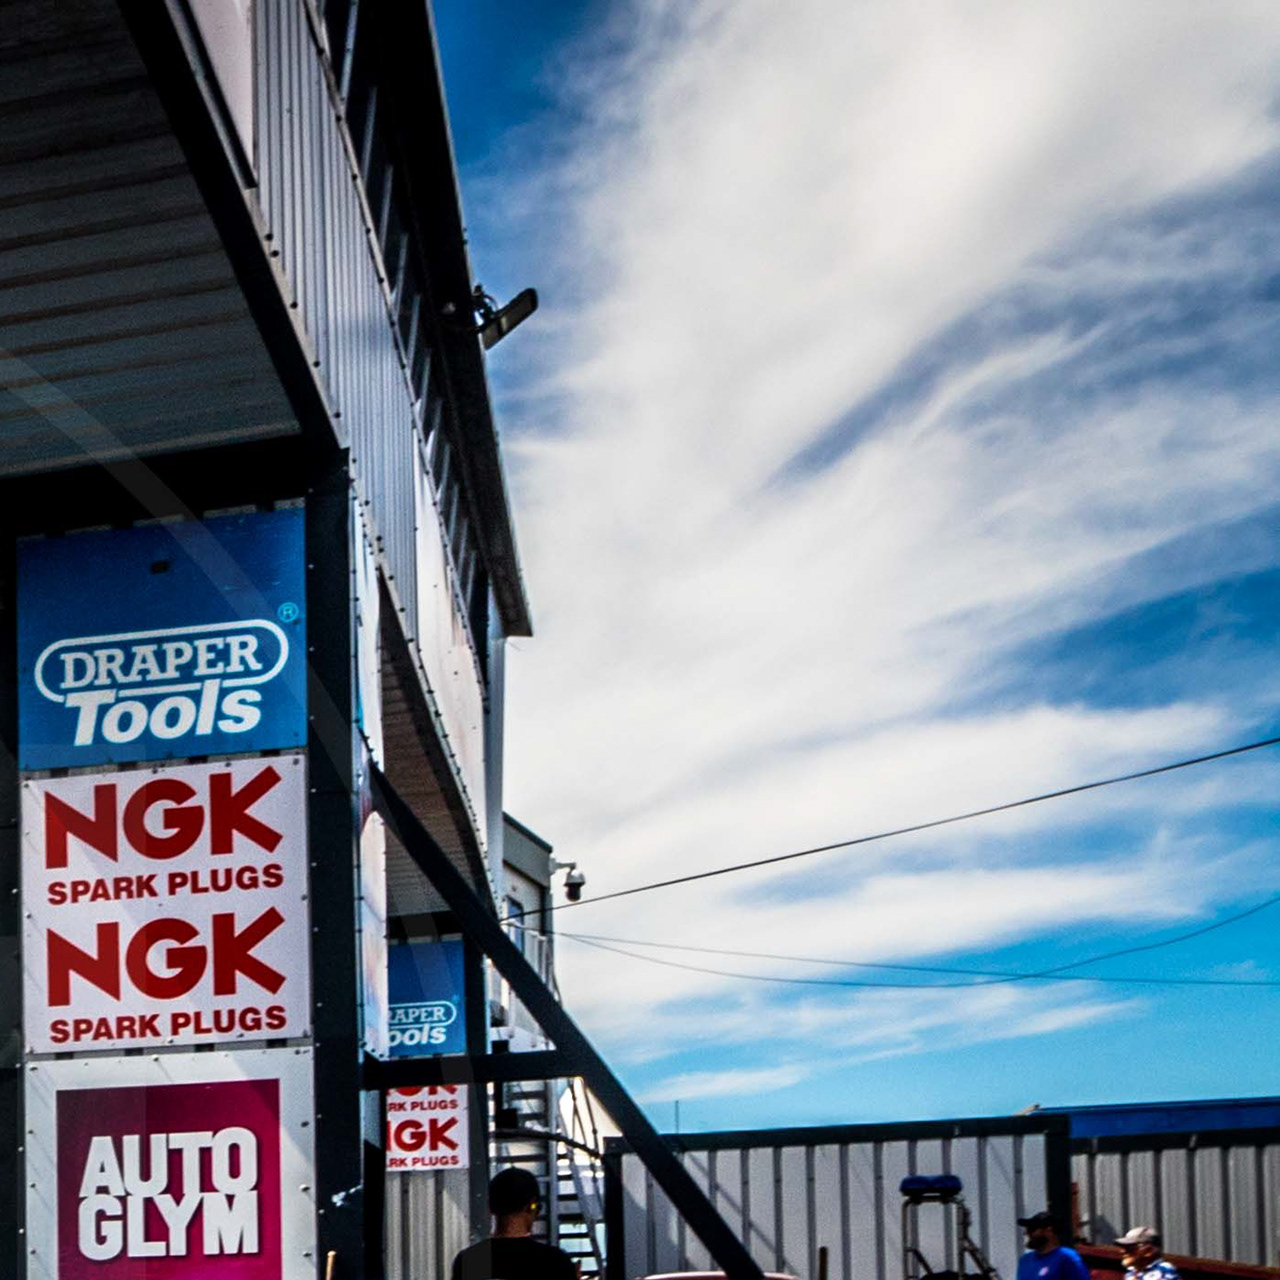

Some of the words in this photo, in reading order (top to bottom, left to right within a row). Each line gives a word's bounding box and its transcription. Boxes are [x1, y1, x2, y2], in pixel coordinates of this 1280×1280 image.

[59, 634, 264, 691] DRAPER
[63, 680, 263, 746] Tools
[43, 765, 284, 869] NGK
[47, 874, 159, 905] SPARK
[167, 863, 284, 896] PLUGS
[46, 906, 287, 1007] NGK
[50, 1013, 161, 1043] SPARK
[170, 1005, 287, 1035] PLUGS
[411, 1099, 459, 1111] PLUGS
[78, 1126, 258, 1197] AUTO
[386, 1117, 459, 1152] GK
[412, 1155, 460, 1167] PLUGS
[78, 1190, 259, 1261] GLYM
